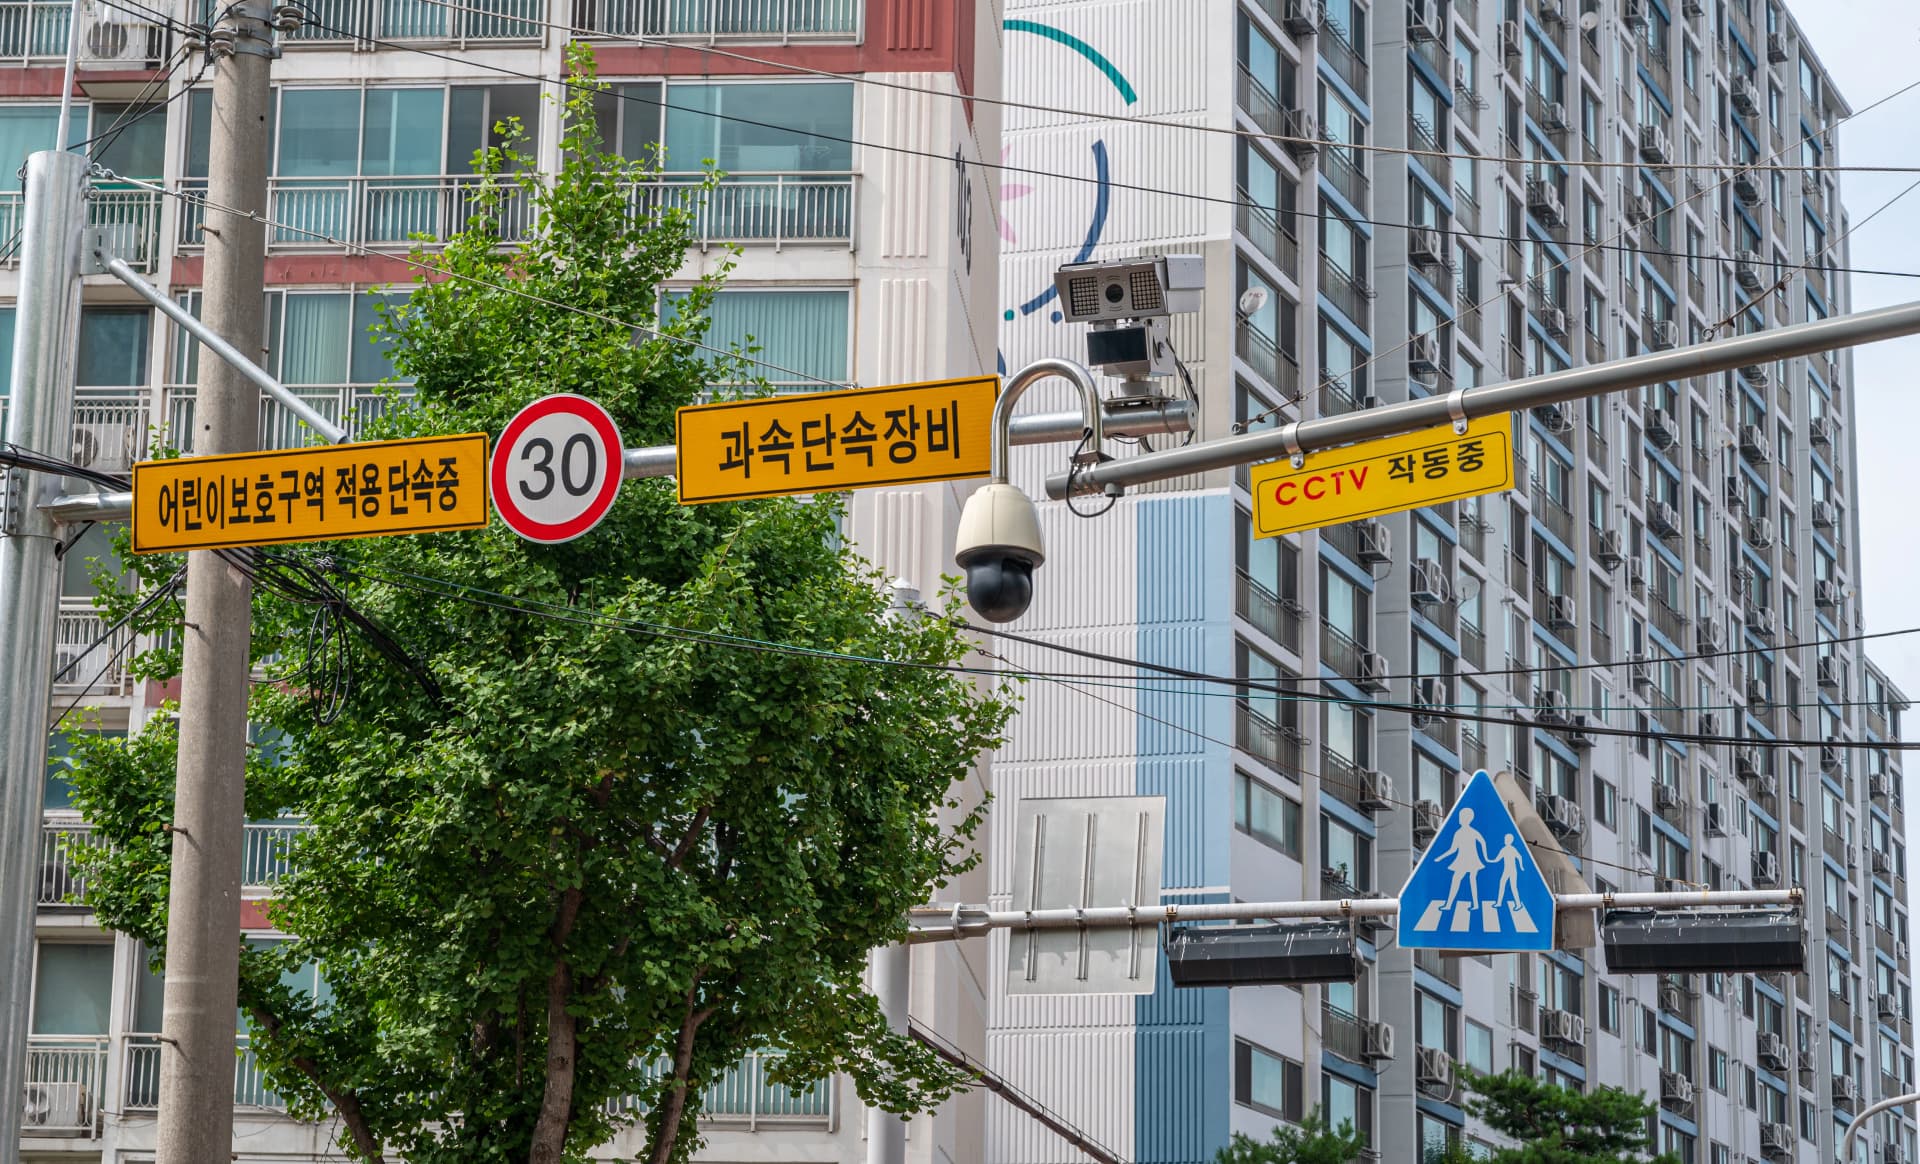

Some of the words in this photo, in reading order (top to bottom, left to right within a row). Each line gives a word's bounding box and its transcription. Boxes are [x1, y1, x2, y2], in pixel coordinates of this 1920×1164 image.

[956, 143, 972, 276] 103
[519, 433, 597, 501] 30
[718, 400, 961, 479] 과속단속장비
[1275, 466, 1369, 506] CCTV
[1387, 440, 1485, 484] 작동중
[158, 466, 325, 533] 어린이보호구역
